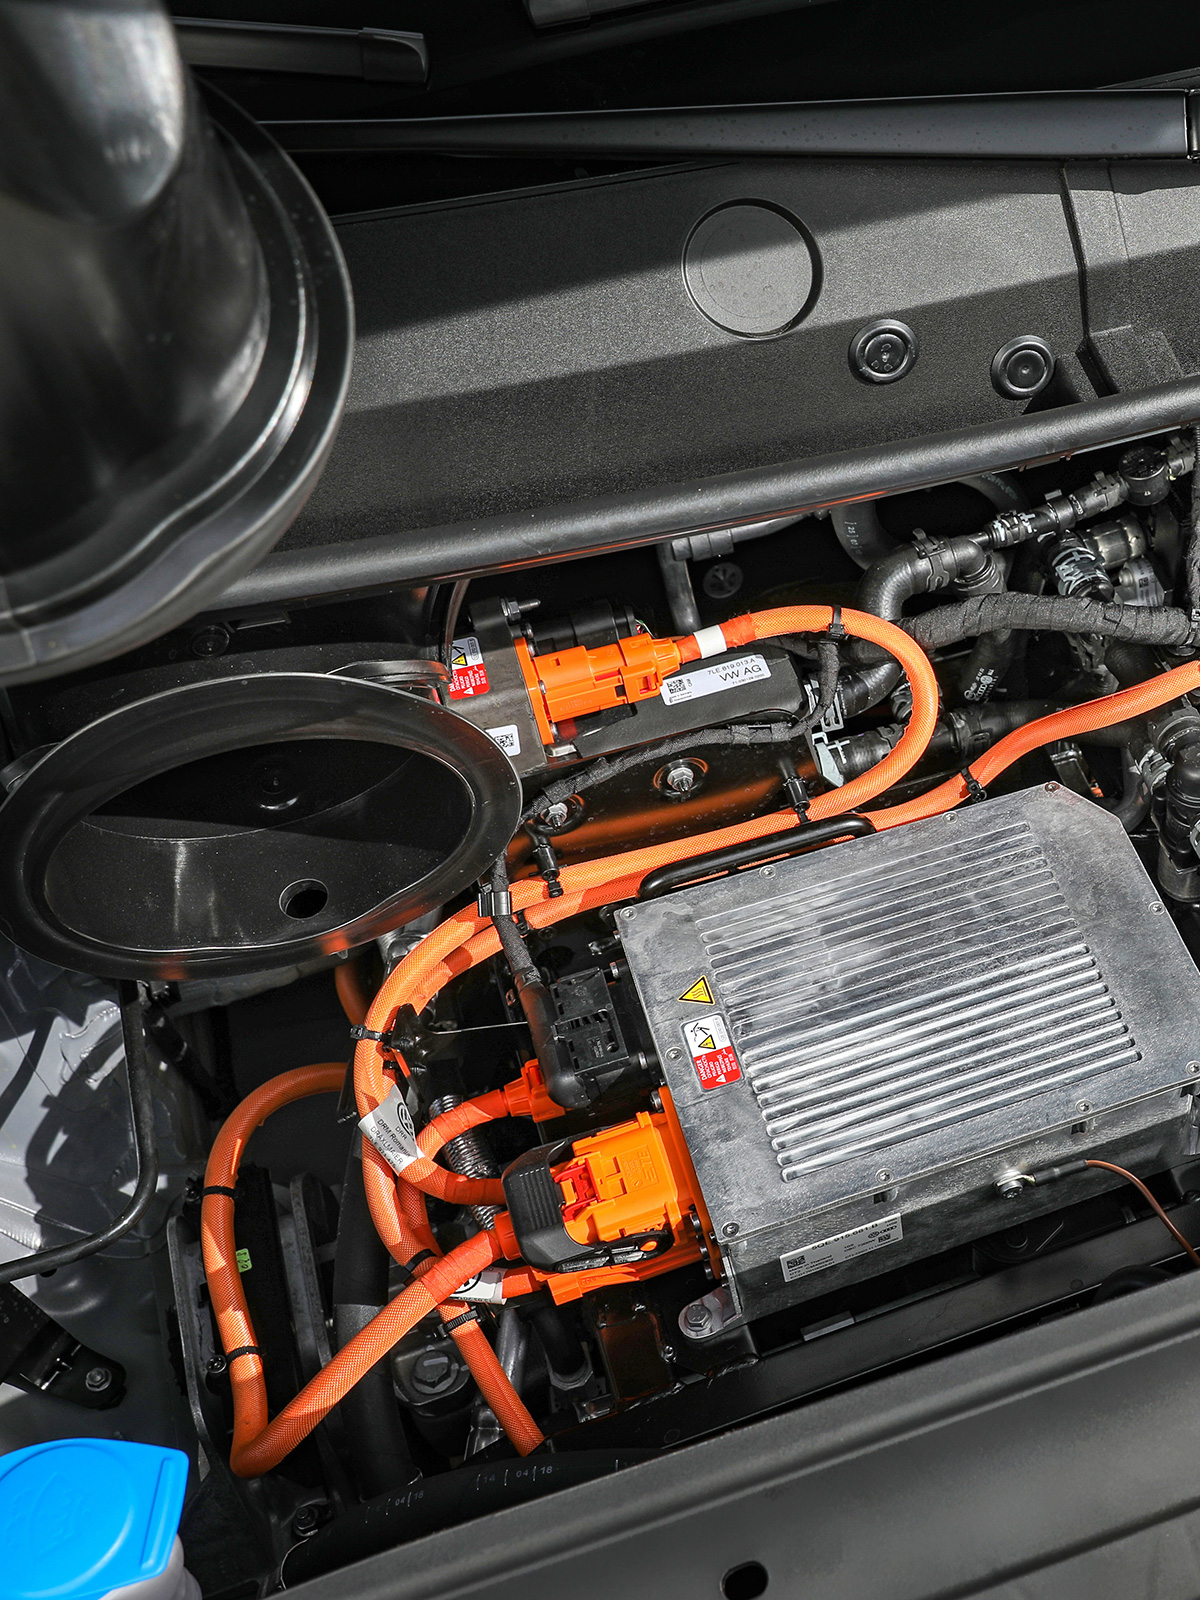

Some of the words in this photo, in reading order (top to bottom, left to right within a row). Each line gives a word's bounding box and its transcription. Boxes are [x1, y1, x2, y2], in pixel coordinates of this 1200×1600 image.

[719, 670, 739, 681] VW
[744, 665, 761, 675] AG
[696, 1059, 707, 1080] DANGER
[377, 1118, 391, 1134] DRM
